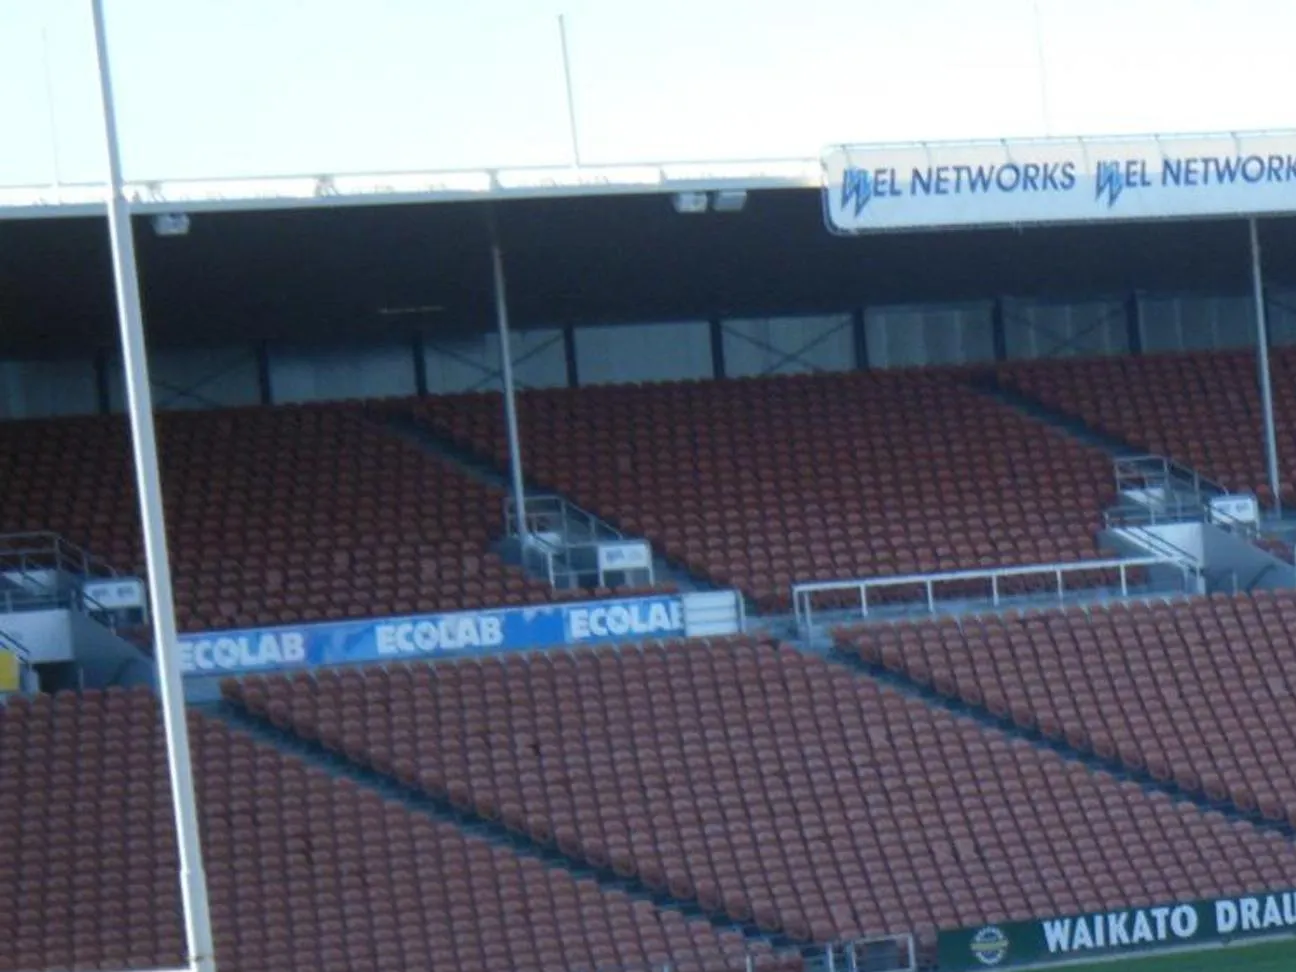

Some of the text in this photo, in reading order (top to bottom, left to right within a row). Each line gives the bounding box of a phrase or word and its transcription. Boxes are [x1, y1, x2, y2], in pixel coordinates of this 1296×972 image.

[910, 161, 1076, 195] NETWORKS
[375, 616, 505, 656] ECOLAB
[1042, 905, 1198, 954] WAIKATO
